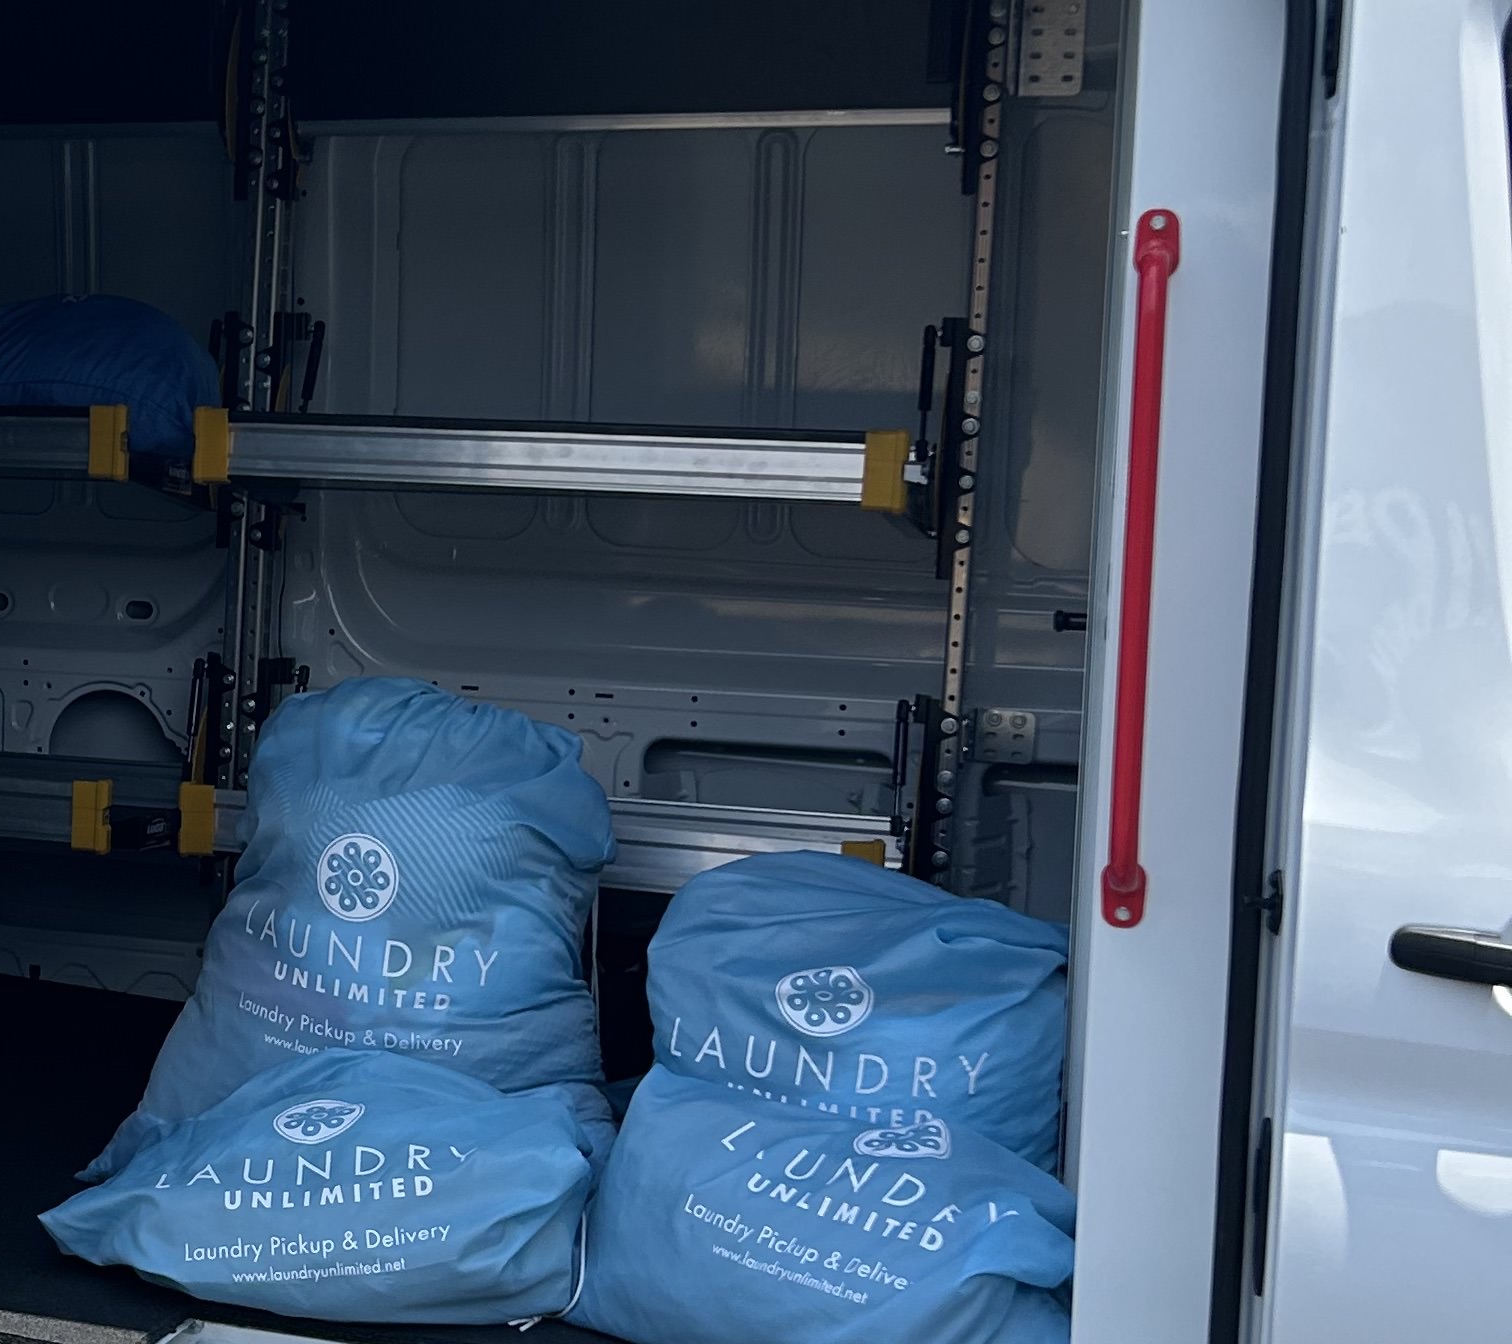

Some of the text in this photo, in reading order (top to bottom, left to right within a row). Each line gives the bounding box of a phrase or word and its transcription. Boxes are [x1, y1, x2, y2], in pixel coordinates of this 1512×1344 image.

[245, 899, 499, 987] LAUNDRY
[273, 960, 451, 1011] UNLIMITED
[239, 991, 463, 1056] Laundry Pickup & Delivery
[670, 1017, 989, 1098] LAUNDRY
[224, 1175, 434, 1210] UNLIMITED
[746, 1171, 945, 1252] UNLIMITED
[184, 1224, 451, 1262] Laundry Pickup & Delivery
[232, 1257, 406, 1284] www.laundryunlimited.net
[683, 1193, 908, 1292] Laundry Pickup & Delive
[711, 1242, 869, 1305] www.laundryunlimited.net
